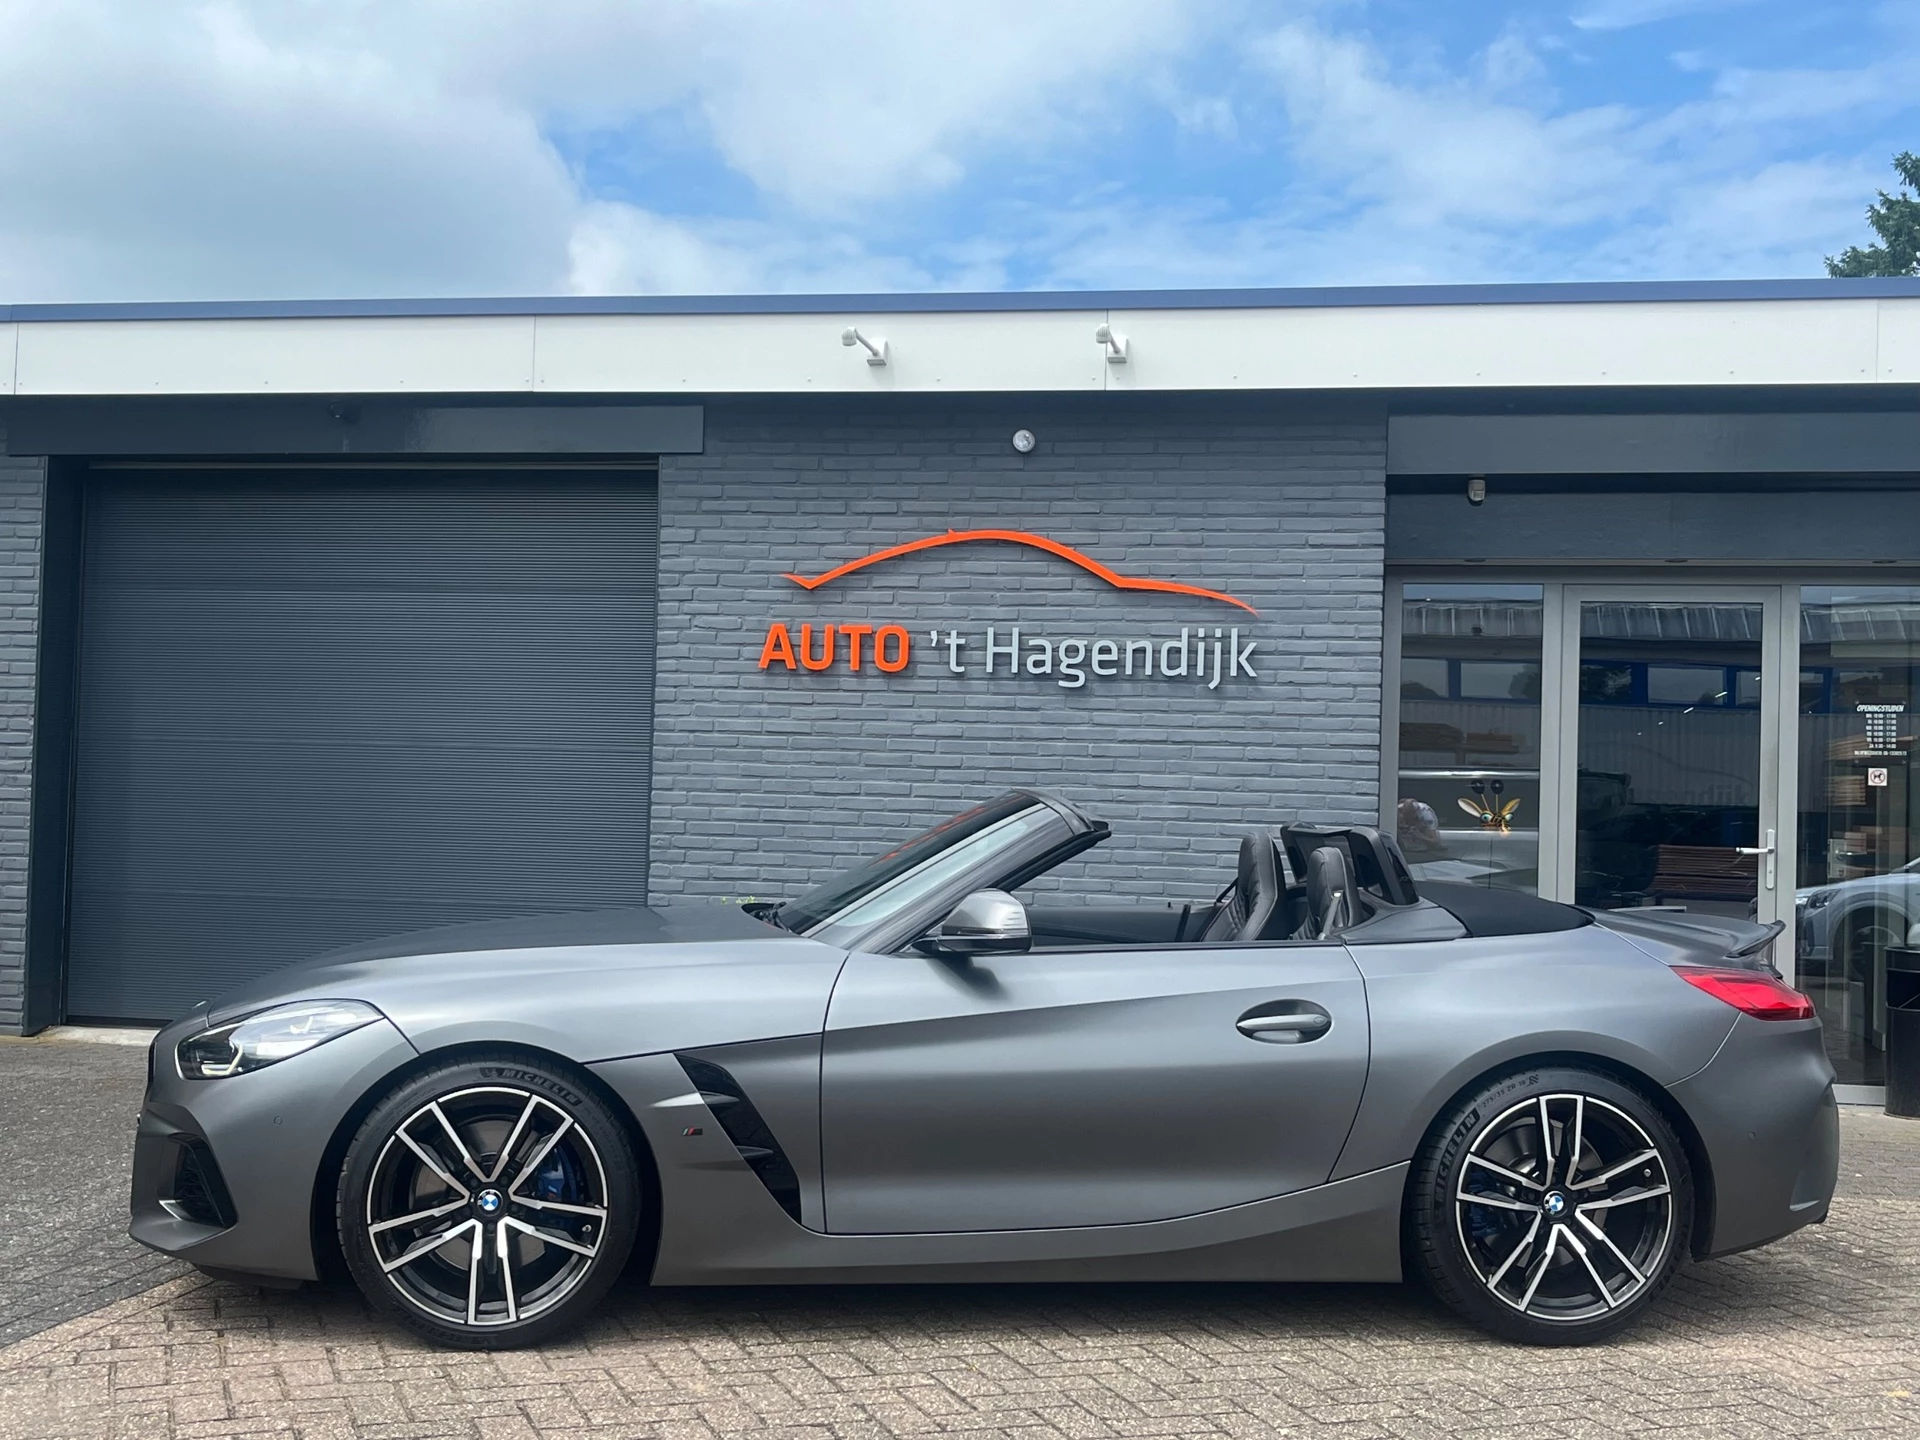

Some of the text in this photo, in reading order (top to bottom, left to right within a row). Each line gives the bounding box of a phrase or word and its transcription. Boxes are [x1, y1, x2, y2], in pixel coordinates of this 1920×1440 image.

[758, 623, 910, 673] AUTO
[985, 626, 1259, 690] Hagendijk
[500, 1068, 578, 1104] MICHELIN
[1506, 1083, 1517, 1092] ZR
[1434, 1112, 1477, 1203] MICHELIN
